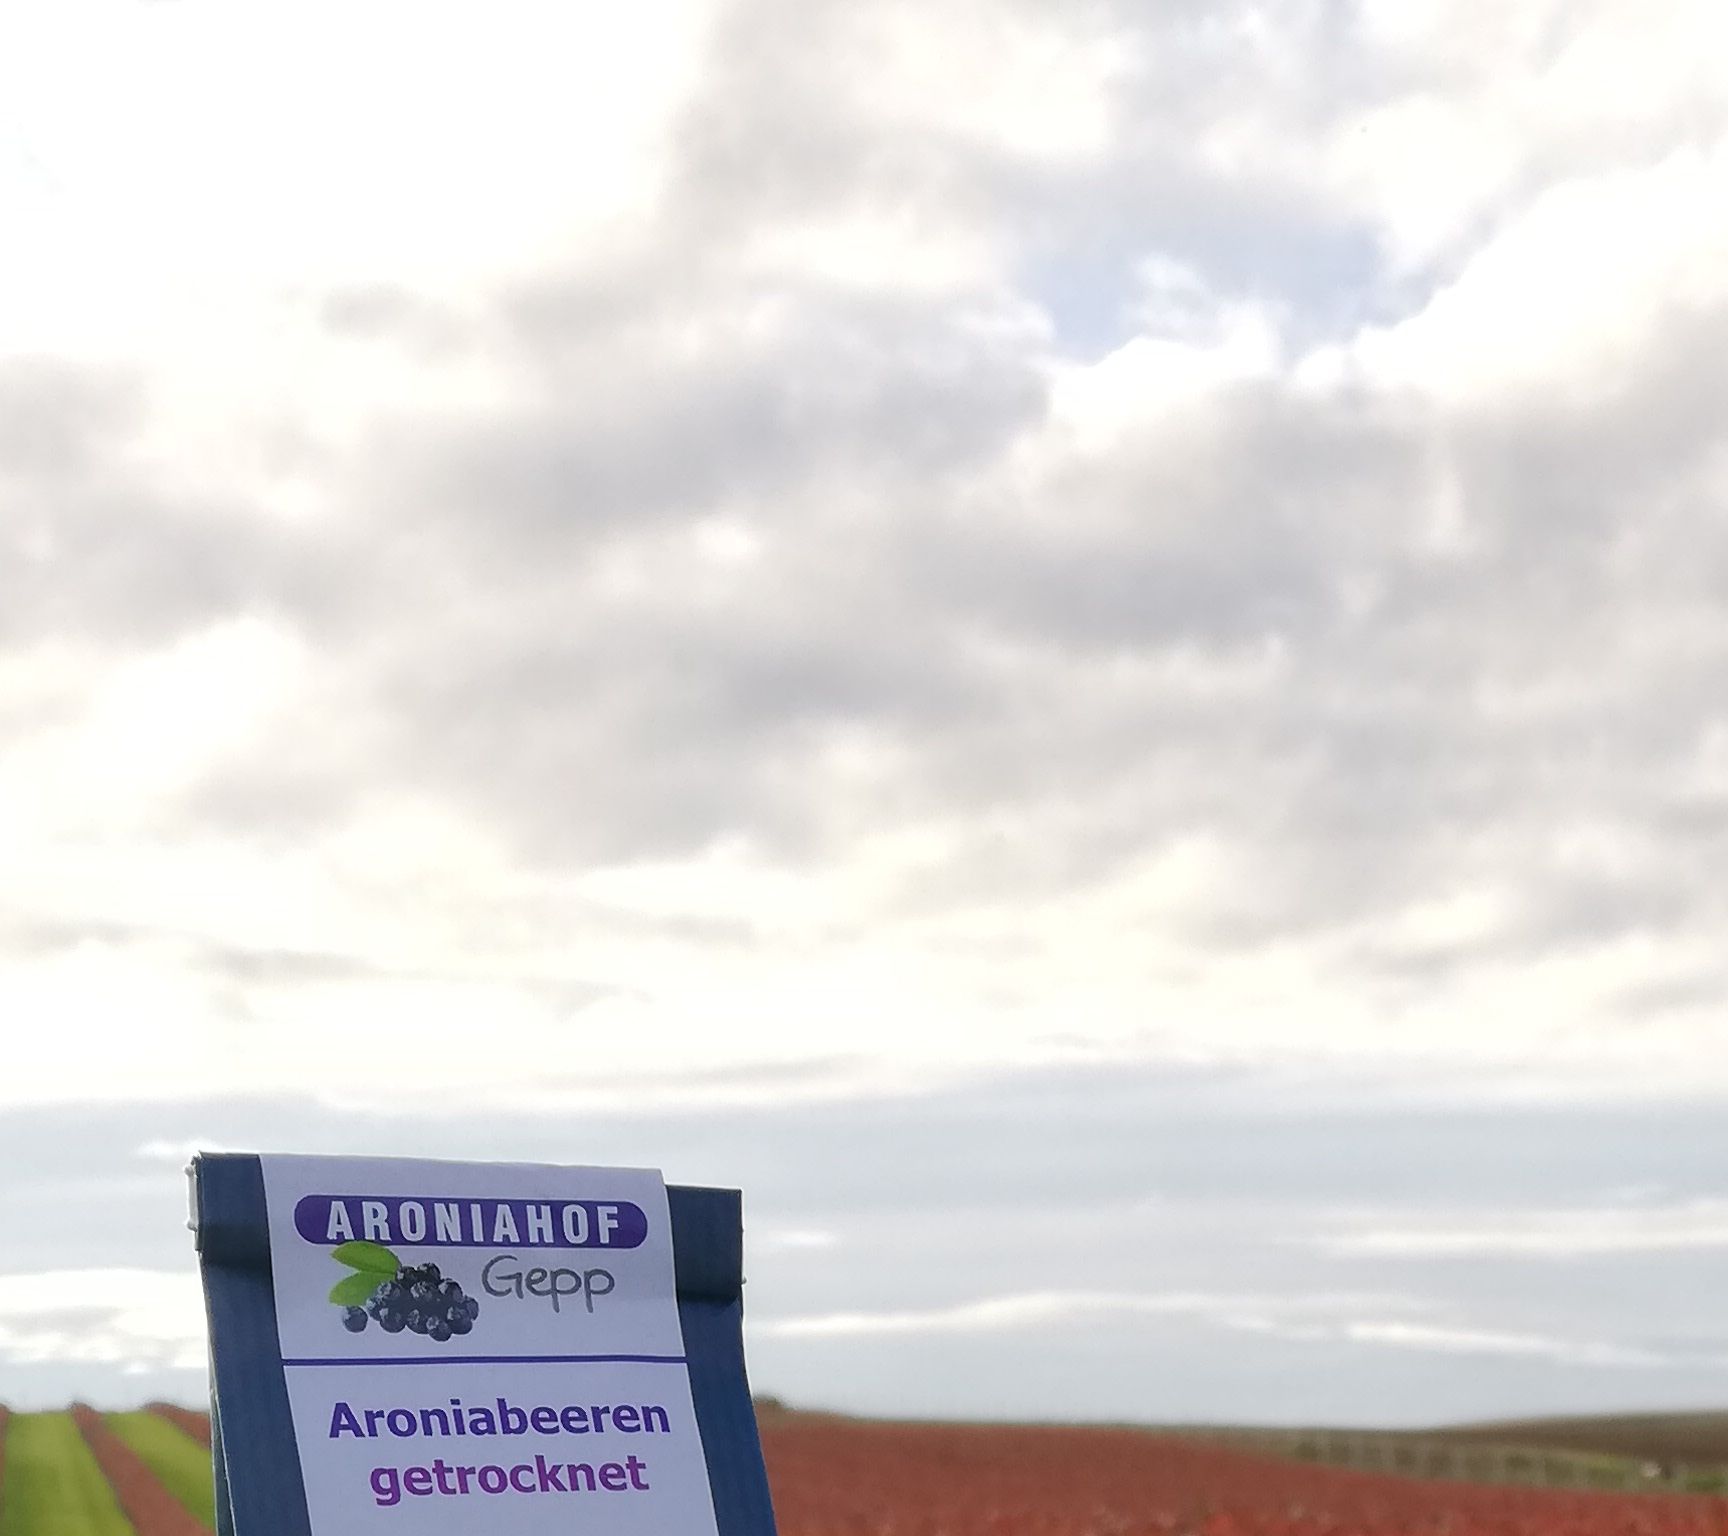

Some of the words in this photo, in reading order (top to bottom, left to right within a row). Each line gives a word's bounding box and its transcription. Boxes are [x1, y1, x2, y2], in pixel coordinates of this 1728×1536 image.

[326, 1198, 621, 1244] ARONIAHOF
[480, 1254, 616, 1313] Gepp
[329, 1398, 671, 1439] Aroniabeeren
[369, 1455, 650, 1507] getrocknet
